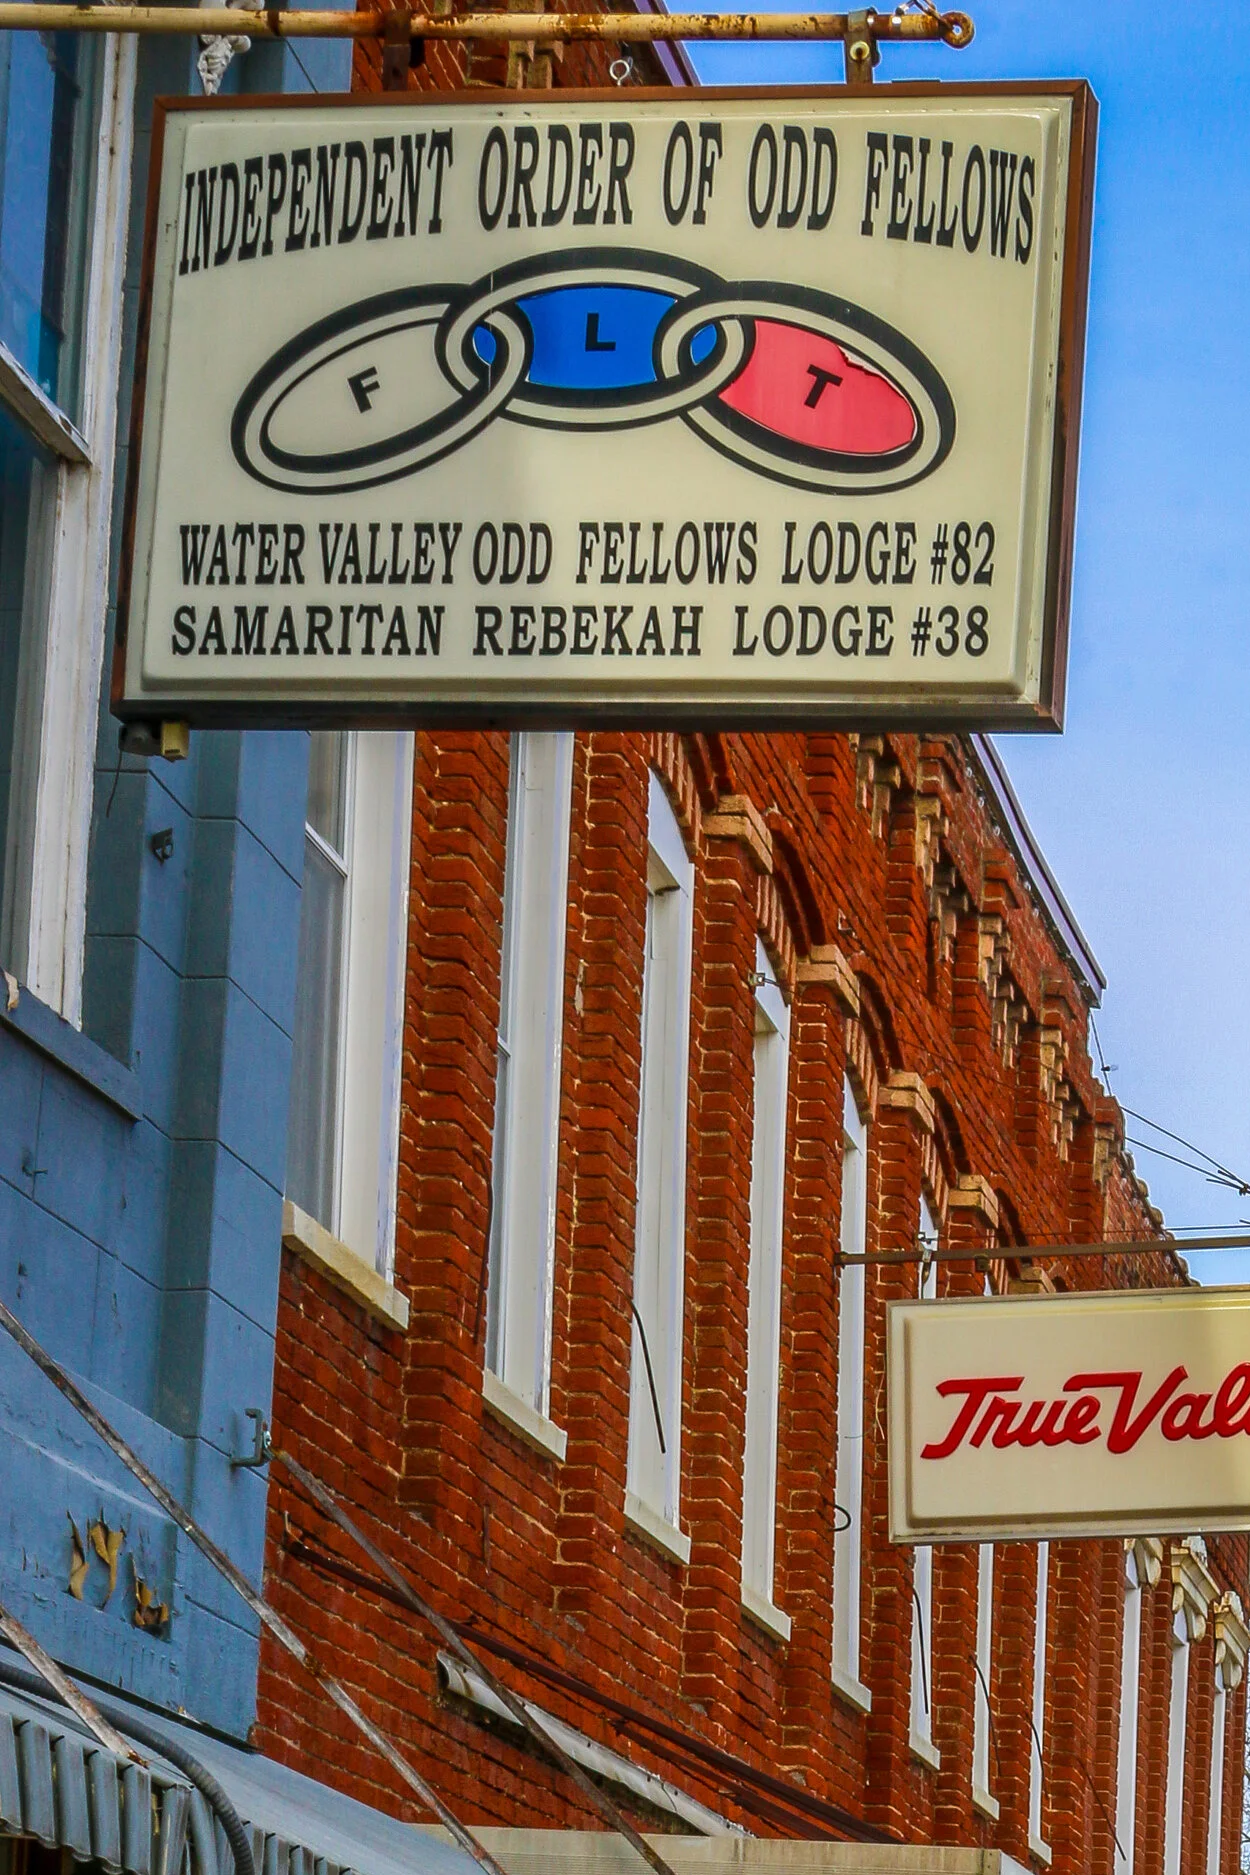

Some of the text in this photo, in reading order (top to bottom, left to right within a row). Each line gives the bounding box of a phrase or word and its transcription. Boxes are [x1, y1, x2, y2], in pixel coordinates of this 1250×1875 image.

[179, 120, 1036, 275] INDEPENDENT ORDER OF ODD FELLOWS
[585, 312, 617, 353] L
[346, 366, 383, 414] F
[804, 363, 844, 409] T
[179, 521, 996, 587] WATER VALLEY ODD FELLOWS LODGE #82
[172, 604, 990, 657] SAMARITAN REBEKAH LODGE #38
